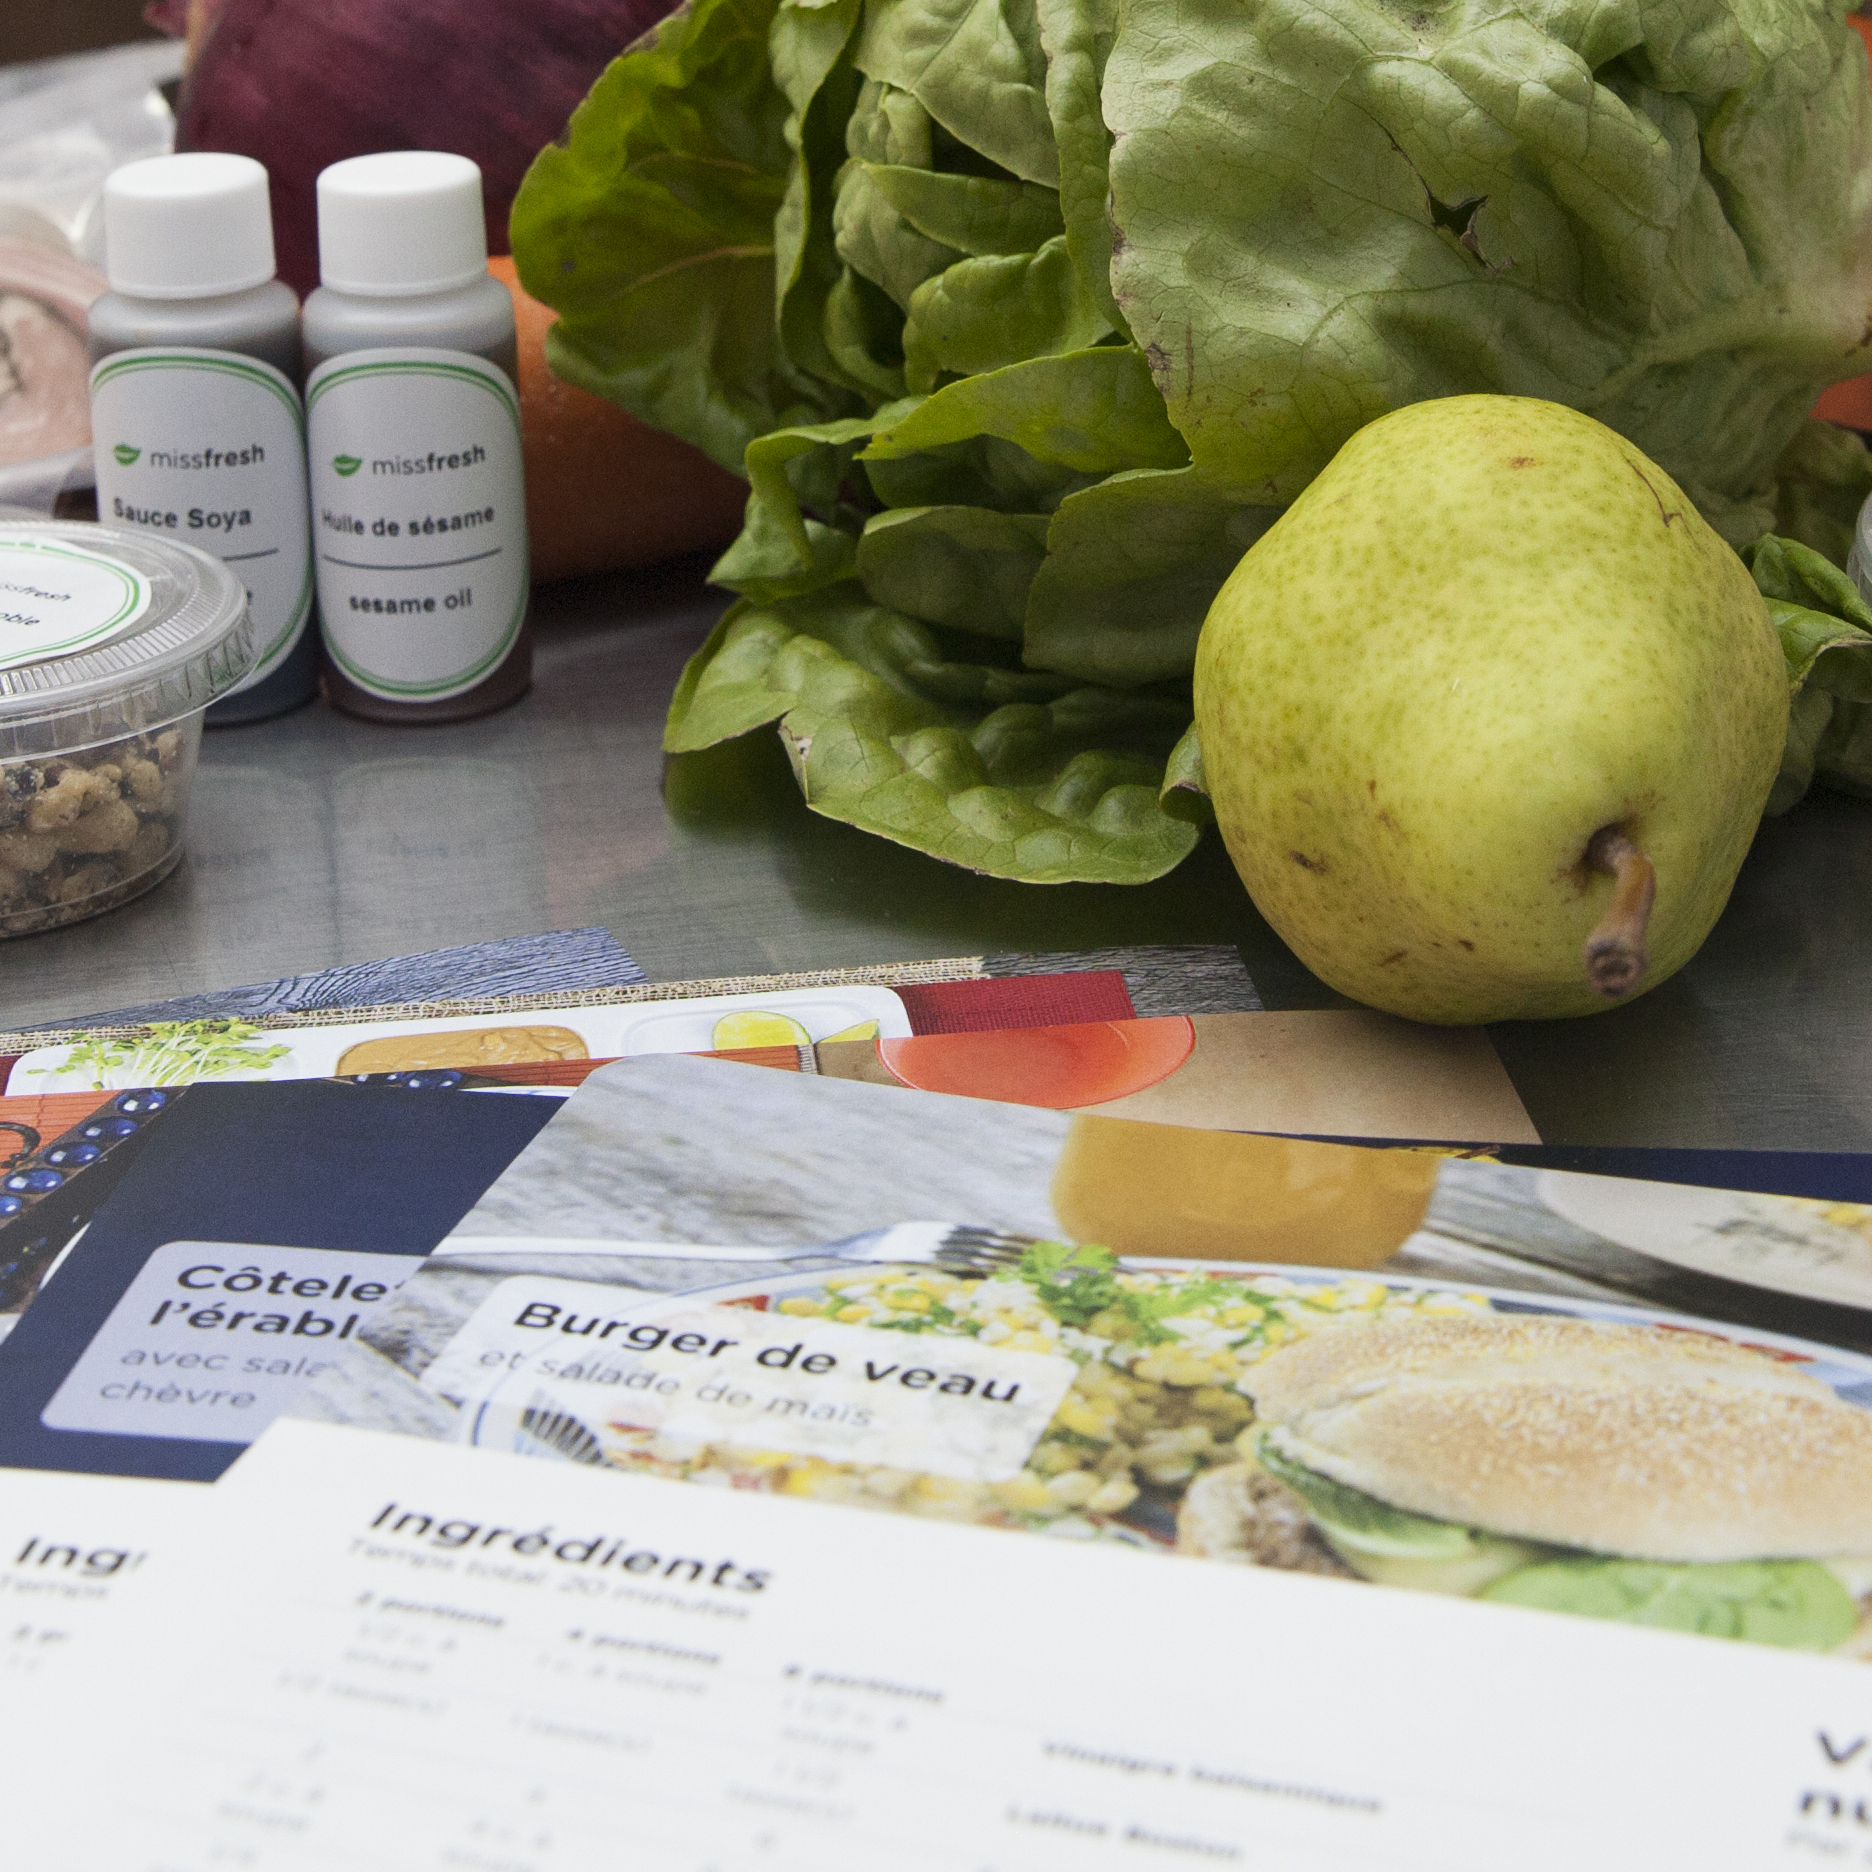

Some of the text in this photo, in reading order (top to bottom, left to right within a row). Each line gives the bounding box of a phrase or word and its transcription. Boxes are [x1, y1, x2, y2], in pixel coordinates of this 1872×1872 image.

[149, 442, 266, 470] missfresh
[371, 443, 486, 476] missfresh
[113, 496, 253, 534] Sauce Soya
[371, 517, 400, 537] de
[408, 505, 495, 536] sésame
[349, 587, 473, 614] sesame oil
[119, 1348, 229, 1371] avec
[512, 1302, 1023, 1405] Burger de veau
[99, 1379, 258, 1410] chèvre
[478, 1347, 875, 1428] et salade de maïs
[369, 1501, 773, 1594] Ingrédients
